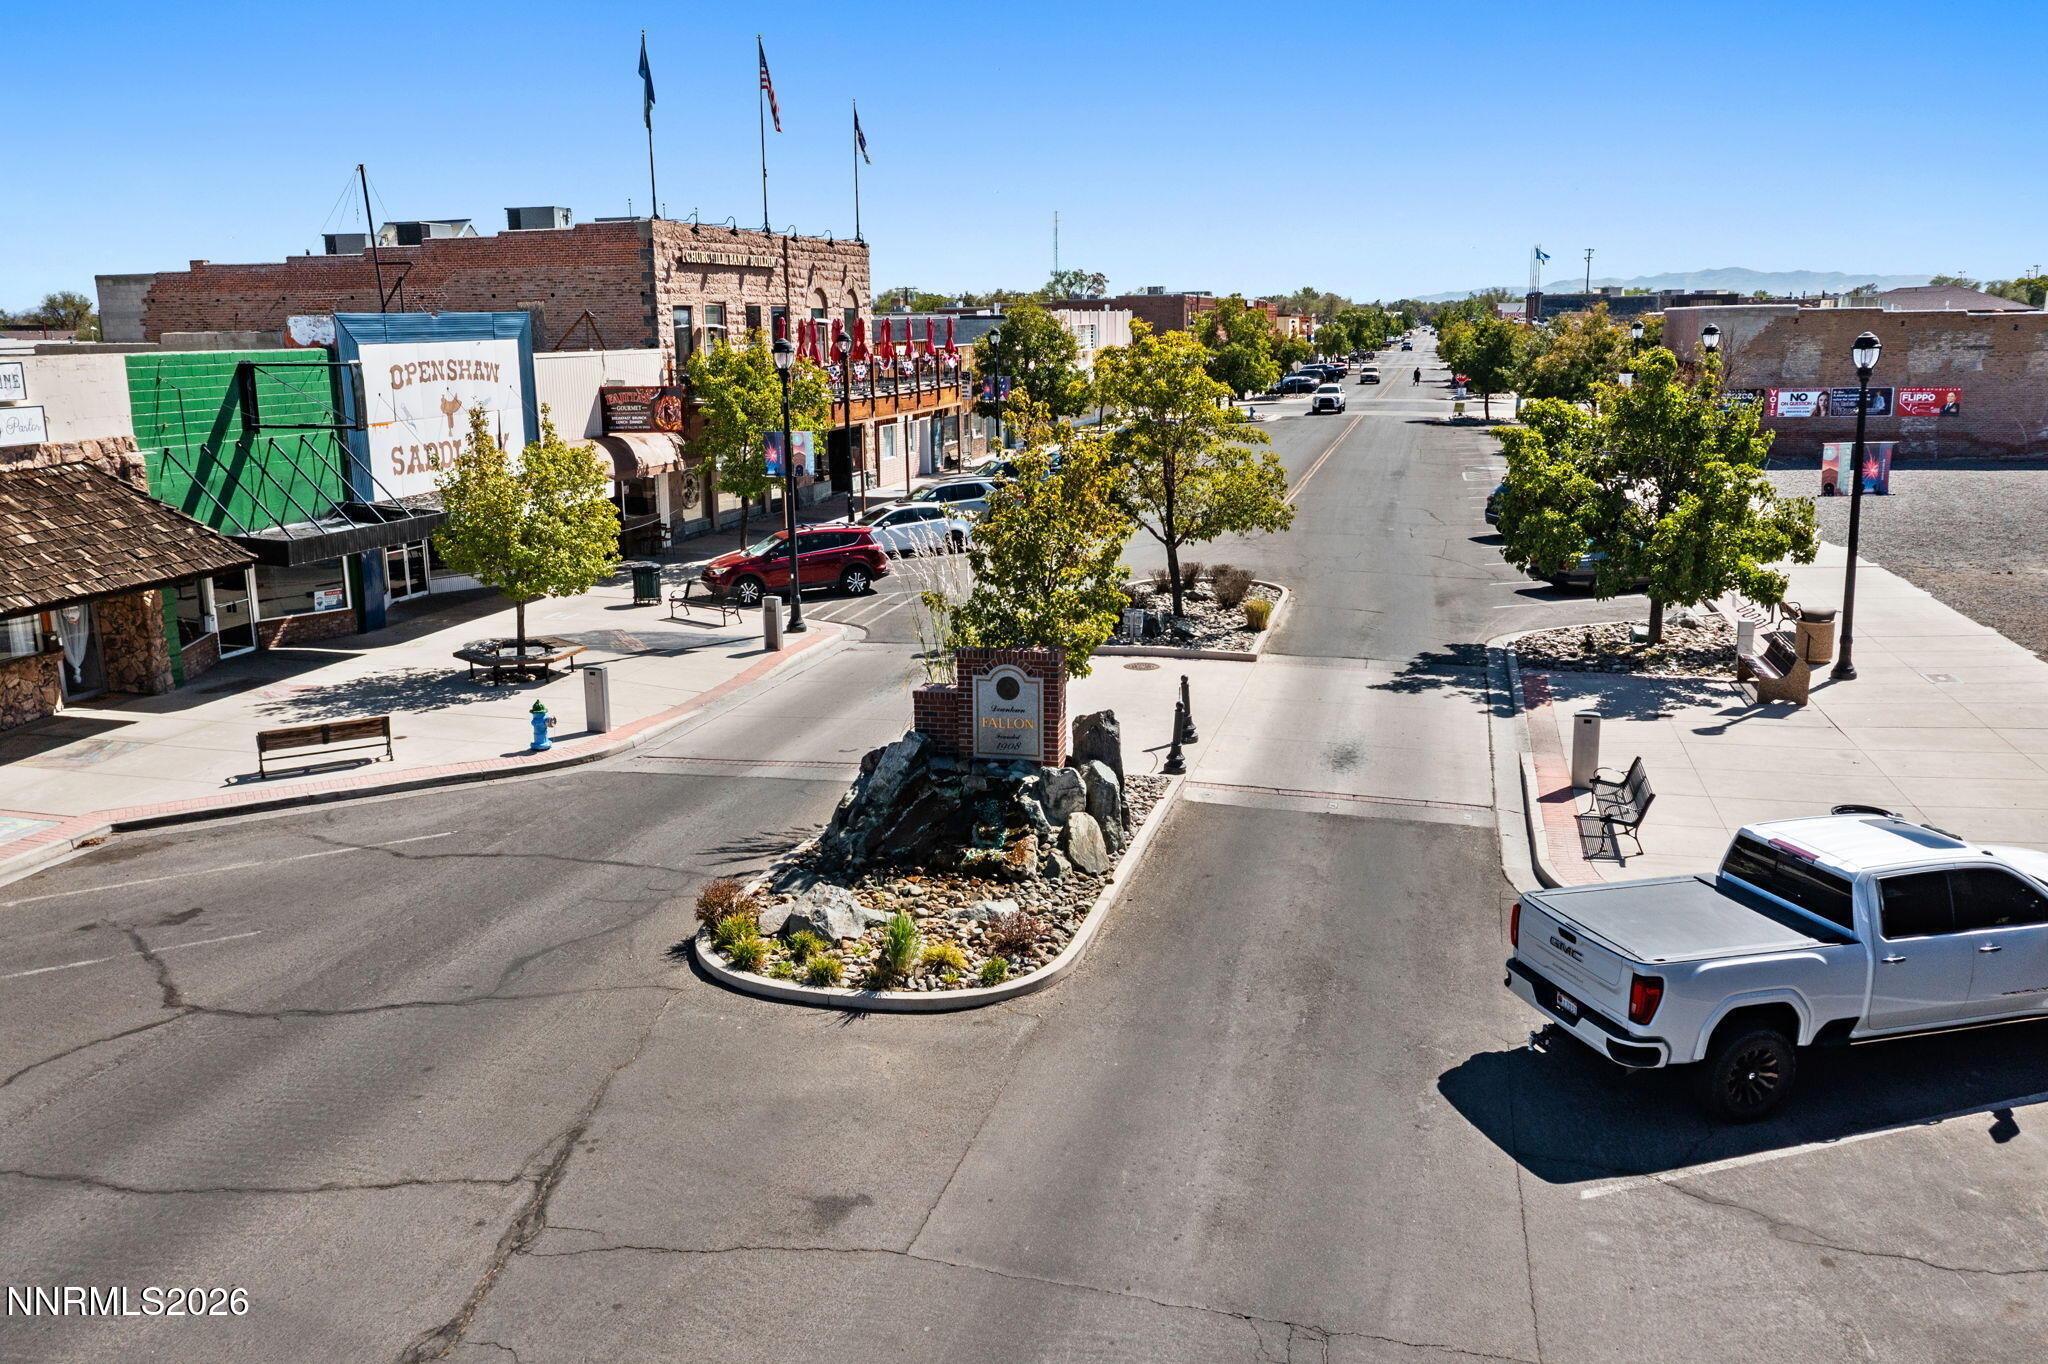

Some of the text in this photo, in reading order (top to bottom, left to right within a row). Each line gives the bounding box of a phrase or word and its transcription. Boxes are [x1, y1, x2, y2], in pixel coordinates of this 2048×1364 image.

[729, 254, 748, 266] BANK
[0, 374, 21, 389] NE
[389, 359, 500, 390] OPENSHAW
[605, 391, 651, 405] FAJITAS
[1769, 389, 1777, 416] VOTE
[1790, 393, 1808, 402] NO
[1902, 393, 1936, 401] FLIPPO
[6, 416, 41, 435] Parlor
[391, 432, 509, 476] SADDLY
[981, 717, 1034, 728] FALLON
[996, 742, 1022, 751] 1908
[1550, 936, 1584, 963] GMC
